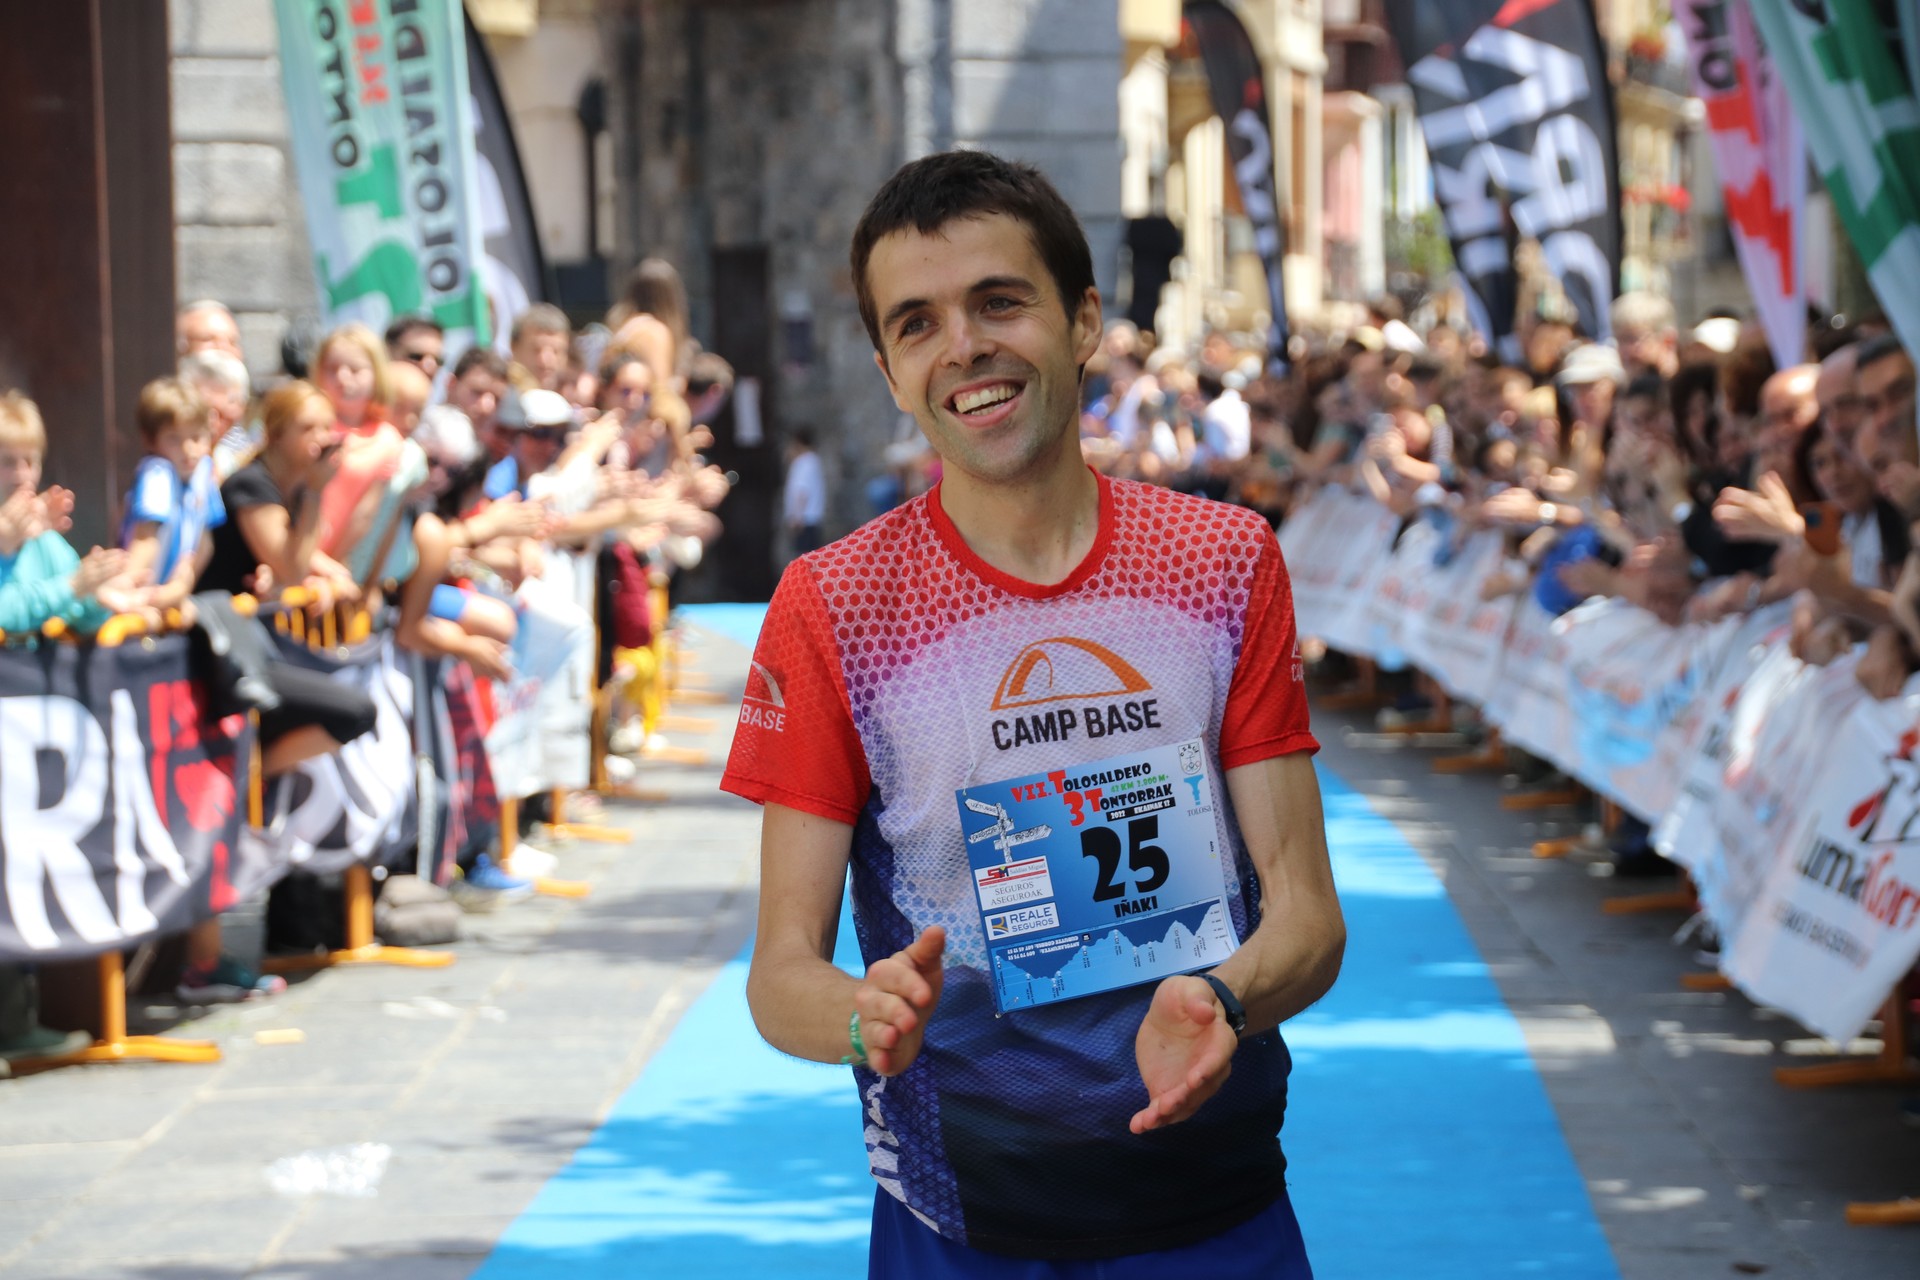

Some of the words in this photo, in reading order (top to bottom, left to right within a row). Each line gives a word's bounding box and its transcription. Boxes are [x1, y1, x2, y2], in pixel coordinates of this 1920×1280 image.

[740, 703, 786, 732] BASE
[991, 708, 1077, 750] CAMP
[1083, 699, 1161, 739] BASE
[1011, 782, 1052, 803] VII.
[1047, 762, 1151, 794] TOLOSALDEKO
[1110, 810, 1126, 819] 2022
[1080, 814, 1170, 902] 25
[991, 889, 1043, 906] ASEGUROAK
[995, 881, 1034, 896] SEGUROS
[1010, 906, 1052, 924] REALE
[1113, 896, 1158, 918] IÑAKI
[1012, 918, 1054, 932] SEGUROS
